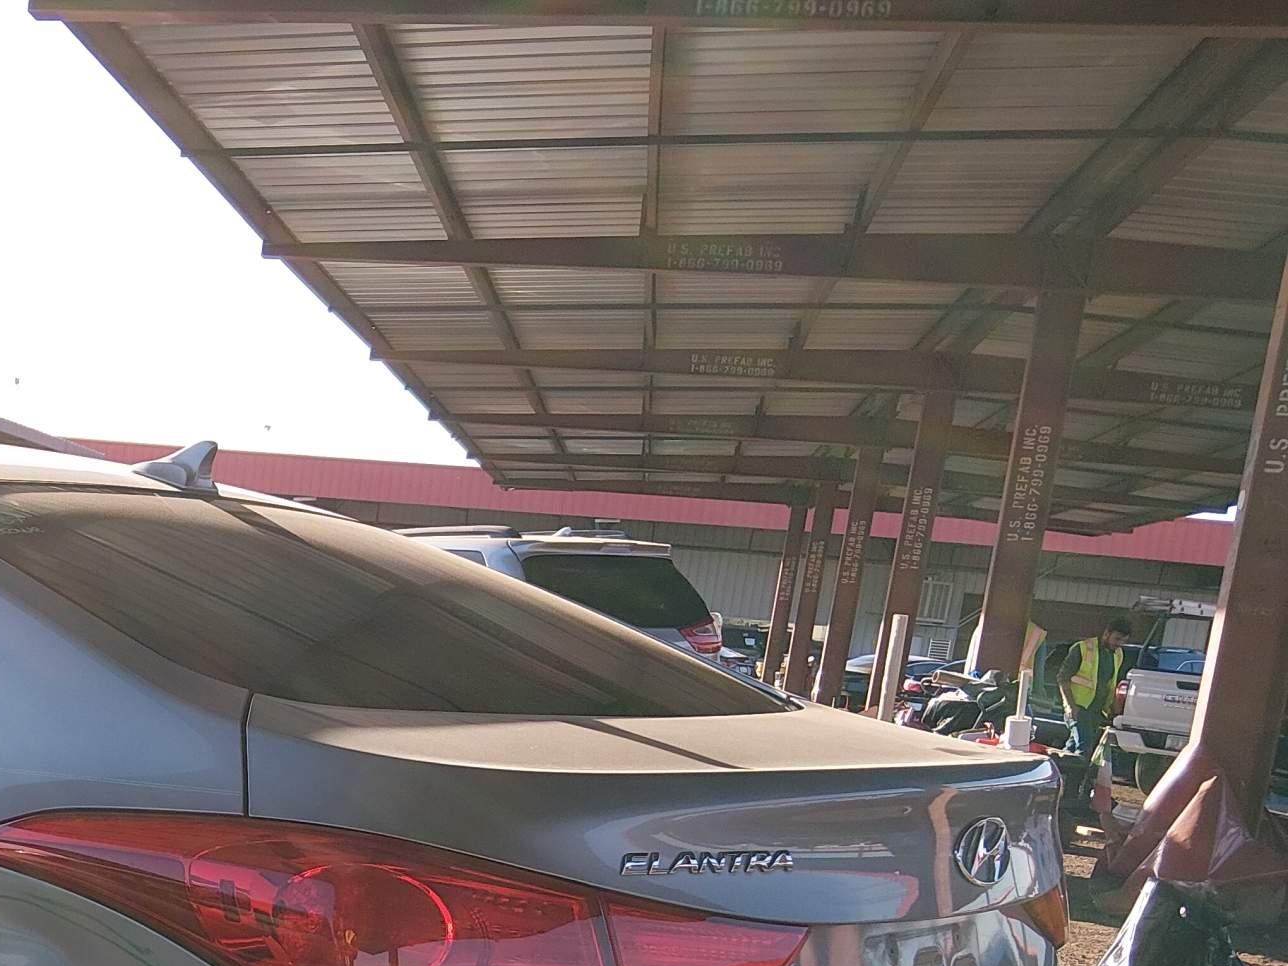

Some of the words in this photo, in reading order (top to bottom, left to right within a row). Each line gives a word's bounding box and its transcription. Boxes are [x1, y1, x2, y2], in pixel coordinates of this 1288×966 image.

[1022, 424, 1039, 450] INC.
[1012, 456, 1033, 509] PREFAB
[904, 509, 920, 547] PREFAB
[620, 850, 794, 875] ELANTRA
